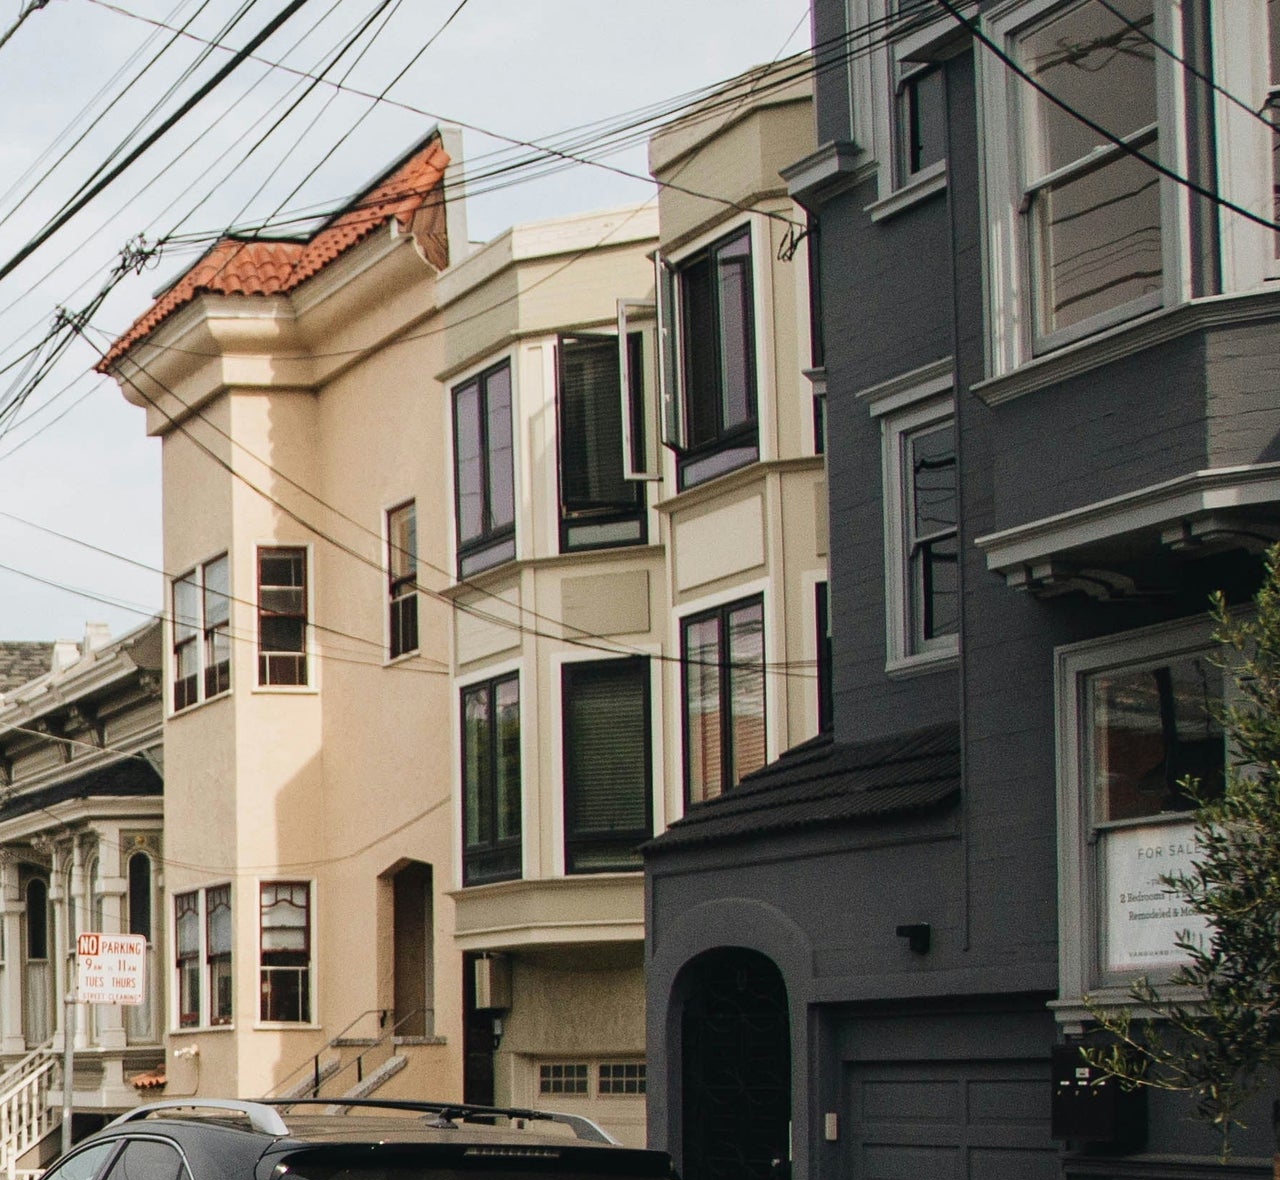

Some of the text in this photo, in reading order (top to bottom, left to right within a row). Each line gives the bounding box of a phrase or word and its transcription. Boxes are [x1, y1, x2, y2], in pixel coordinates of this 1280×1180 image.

[1137, 844, 1201, 860] FOR SALE
[80, 935, 141, 955] NO PARKING
[85, 976, 136, 988] TUES THURS
